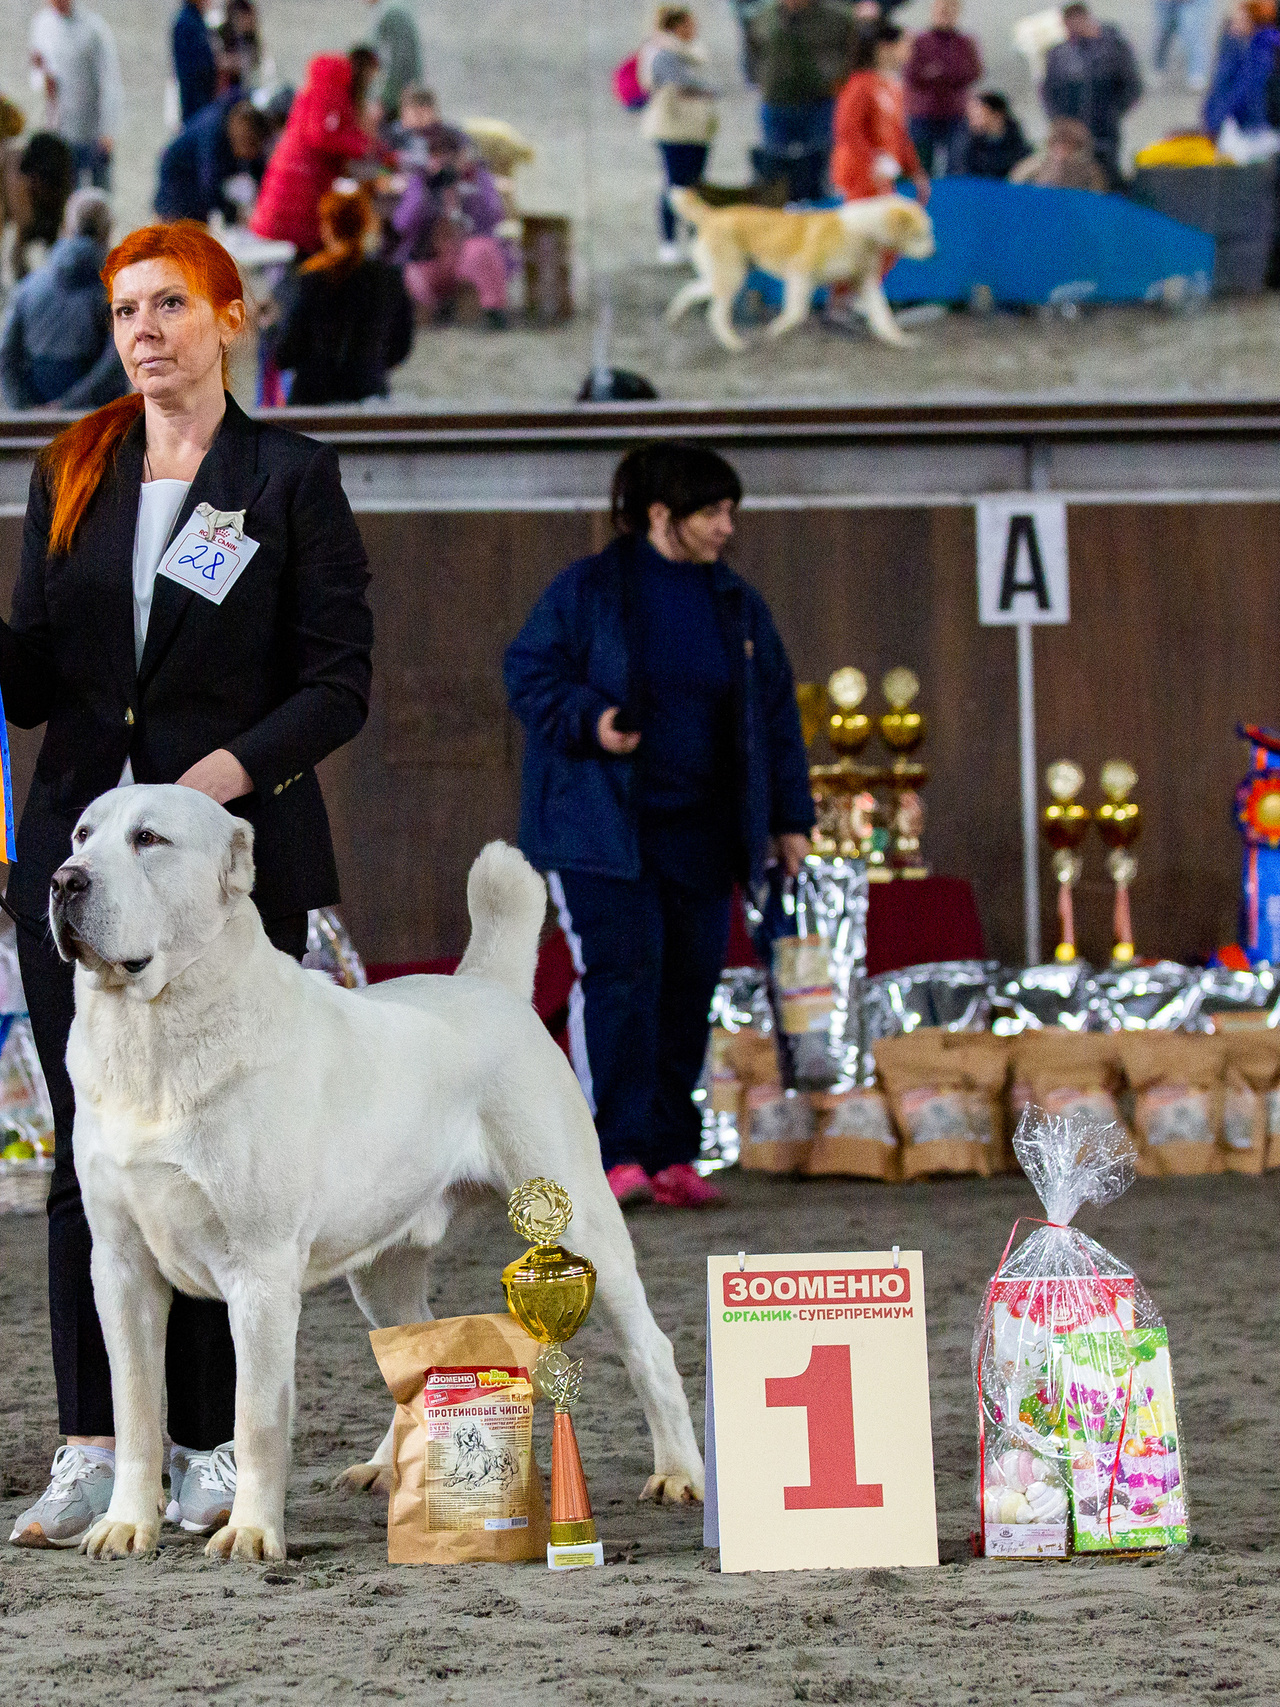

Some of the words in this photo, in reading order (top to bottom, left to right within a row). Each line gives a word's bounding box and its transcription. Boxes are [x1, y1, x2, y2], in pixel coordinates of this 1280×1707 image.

[217, 538, 238, 552] CANIN
[177, 545, 225, 581] 28
[728, 1273, 905, 1301] ЗООМЕНЮ
[428, 1406, 498, 1418] ПРОТЕИНОВЫЕ
[500, 1405, 530, 1415] ЧИПСЫ
[764, 1344, 885, 1511] 1
